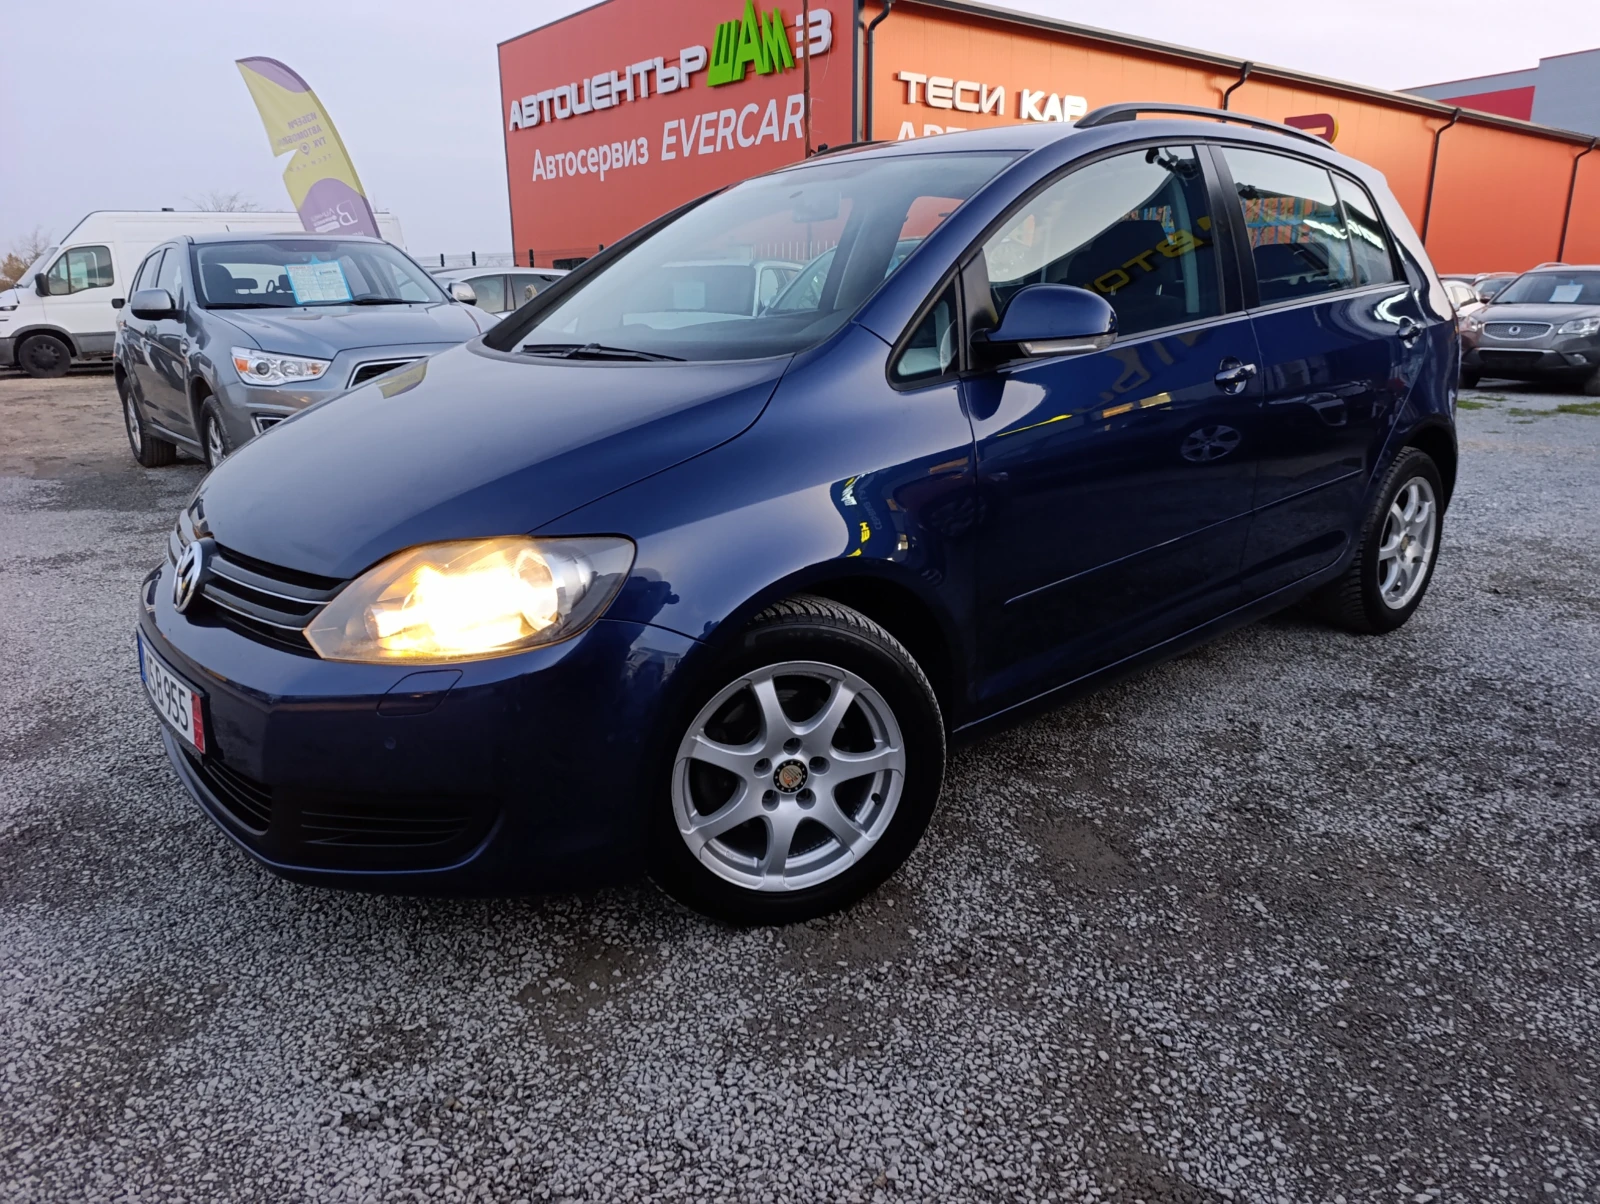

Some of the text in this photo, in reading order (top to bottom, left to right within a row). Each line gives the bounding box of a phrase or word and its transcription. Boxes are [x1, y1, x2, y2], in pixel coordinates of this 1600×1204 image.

[509, 45, 708, 131] АВТОЦЕНТЪР
[707, 0, 795, 87] ШАМ
[898, 70, 1088, 123] ТЕСИ КАР
[532, 93, 805, 182] Автосервиз EVERCAR
